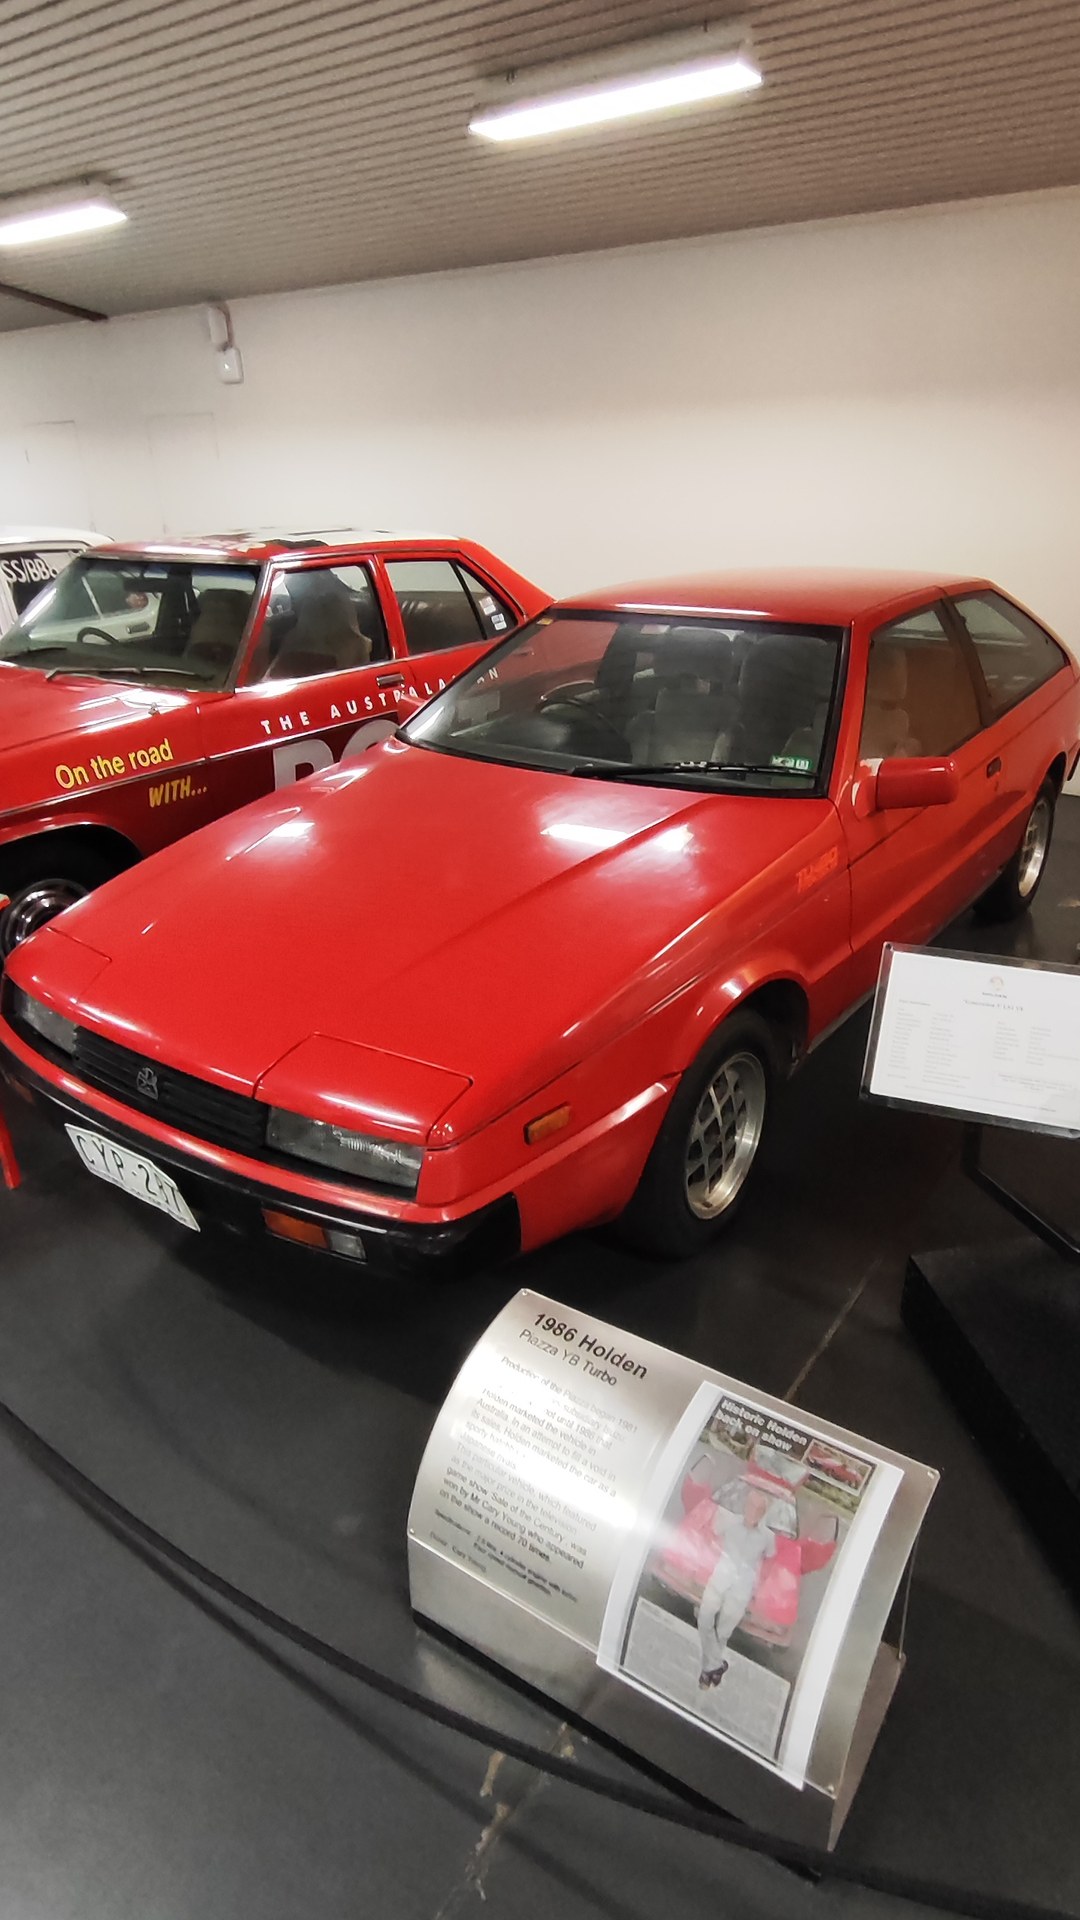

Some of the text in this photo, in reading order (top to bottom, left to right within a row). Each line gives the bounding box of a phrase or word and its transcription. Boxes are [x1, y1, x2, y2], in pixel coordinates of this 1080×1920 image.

[261, 711, 310, 735] THE
[55, 737, 174, 789] On the road
[149, 775, 207, 808] WITH...
[519, 1329, 618, 1387] Piazza YB Turbo
[534, 1313, 648, 1380] 1986 Holden
[549, 1381, 562, 1393] the
[466, 1421, 486, 1437] sporty
[509, 1403, 545, 1426] marketed
[545, 1421, 558, 1434] the
[559, 1431, 586, 1450] vehicle
[587, 1446, 596, 1456] in
[511, 1416, 519, 1427] In
[519, 1423, 530, 1433] an
[531, 1430, 561, 1450] attempt
[561, 1445, 570, 1456] to
[581, 1458, 588, 1466] a
[589, 1461, 607, 1477] void
[607, 1470, 616, 1482] in
[556, 1416, 574, 1428] until
[714, 1408, 793, 1452] back on show
[721, 1399, 808, 1447] Historic Holden
[503, 1426, 530, 1447] Holden
[531, 1444, 568, 1469] marketed
[568, 1464, 582, 1477] the
[583, 1474, 597, 1484] car
[597, 1482, 609, 1492] as
[609, 1489, 616, 1497] a
[439, 1488, 449, 1498] on
[450, 1495, 462, 1506] the
[463, 1504, 482, 1519] show
[491, 1520, 515, 1540] record
[517, 1535, 527, 1547] 70
[446, 1466, 467, 1482] game
[469, 1479, 487, 1495] show
[509, 1505, 518, 1513] of
[519, 1509, 531, 1521] the
[570, 1542, 586, 1555] was
[450, 1455, 576, 1534] as the major prize in the television
[471, 1453, 506, 1476] particular
[538, 1492, 561, 1510] which
[562, 1505, 597, 1531] featured
[443, 1477, 584, 1569] won by Mr Cary Young who appeared
